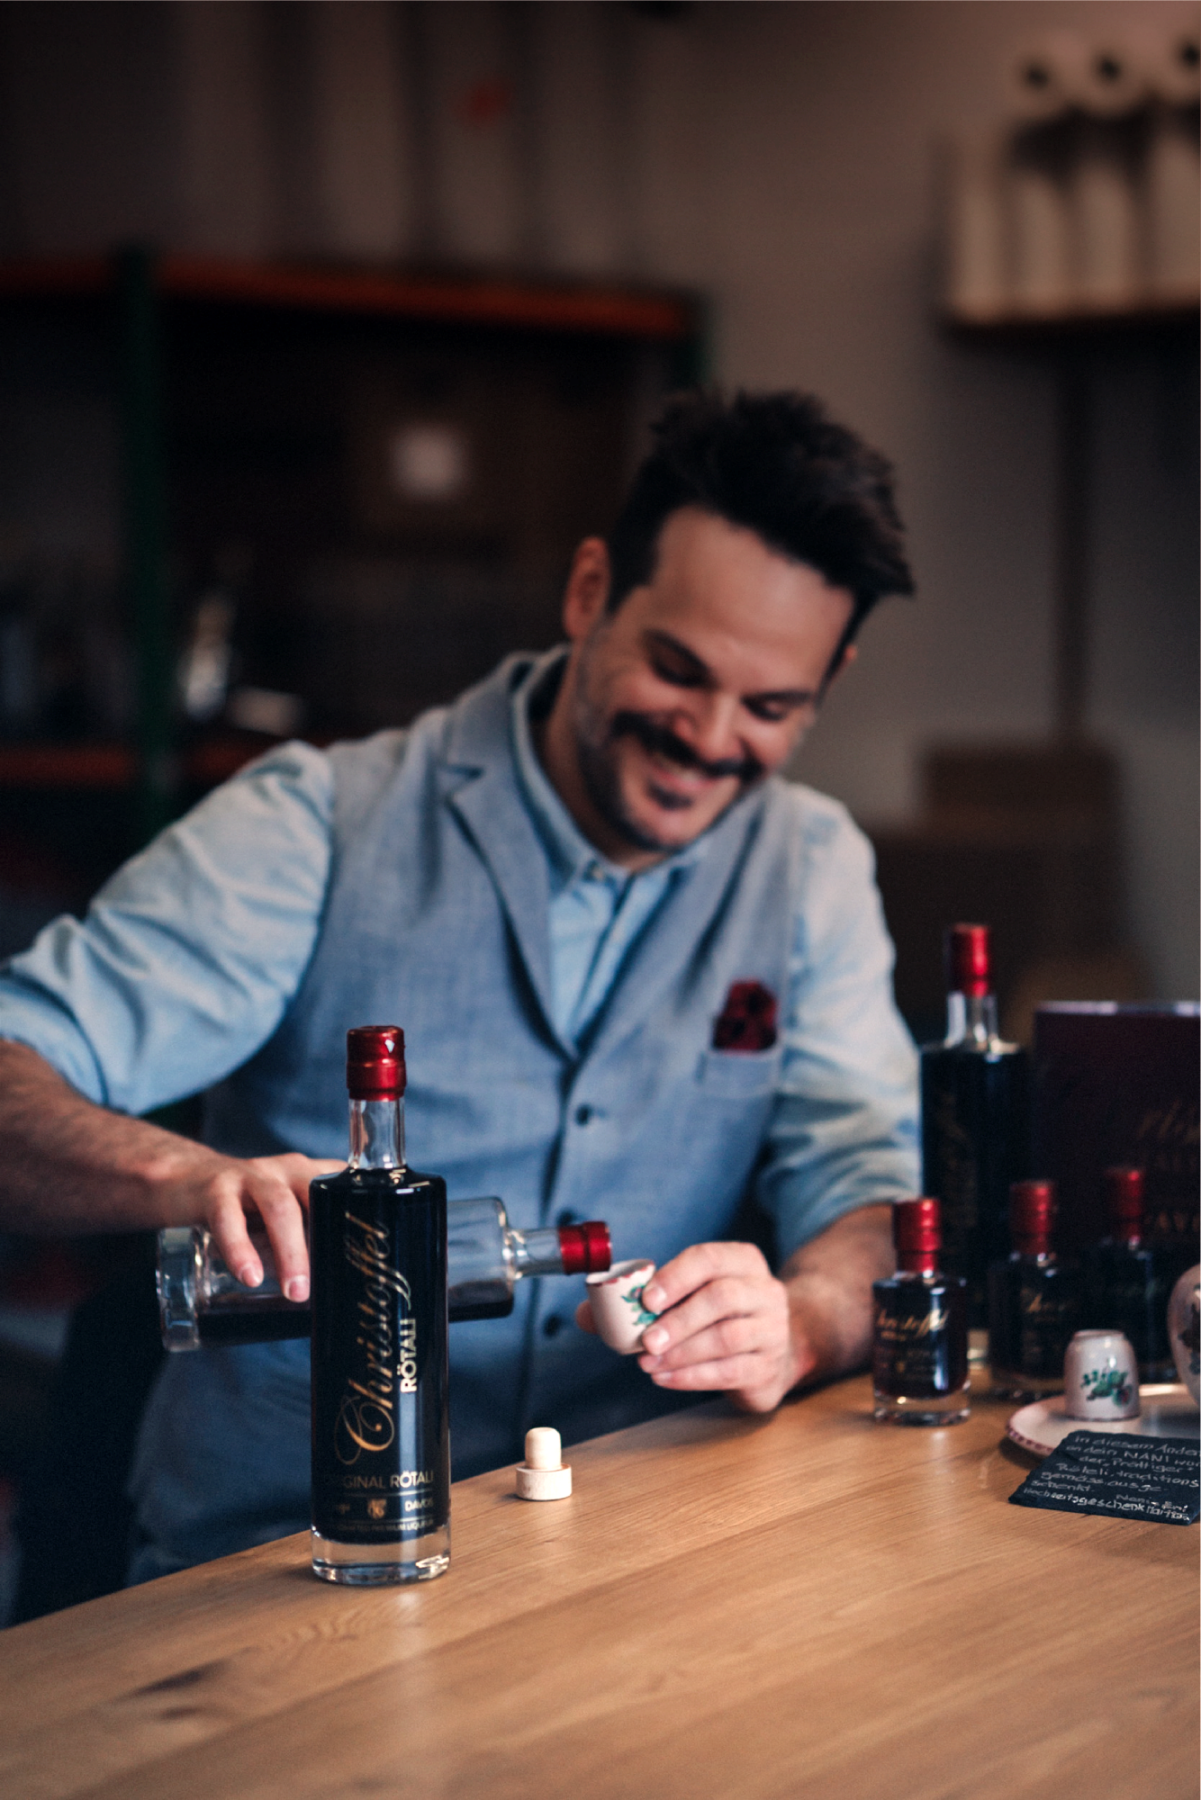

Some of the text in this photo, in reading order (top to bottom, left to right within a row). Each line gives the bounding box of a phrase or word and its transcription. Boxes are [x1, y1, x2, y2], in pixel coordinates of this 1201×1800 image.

[334, 1211, 411, 1466] Christoffel
[397, 1318, 417, 1393] RÖTALI
[1123, 1450, 1169, 1463] NANI
